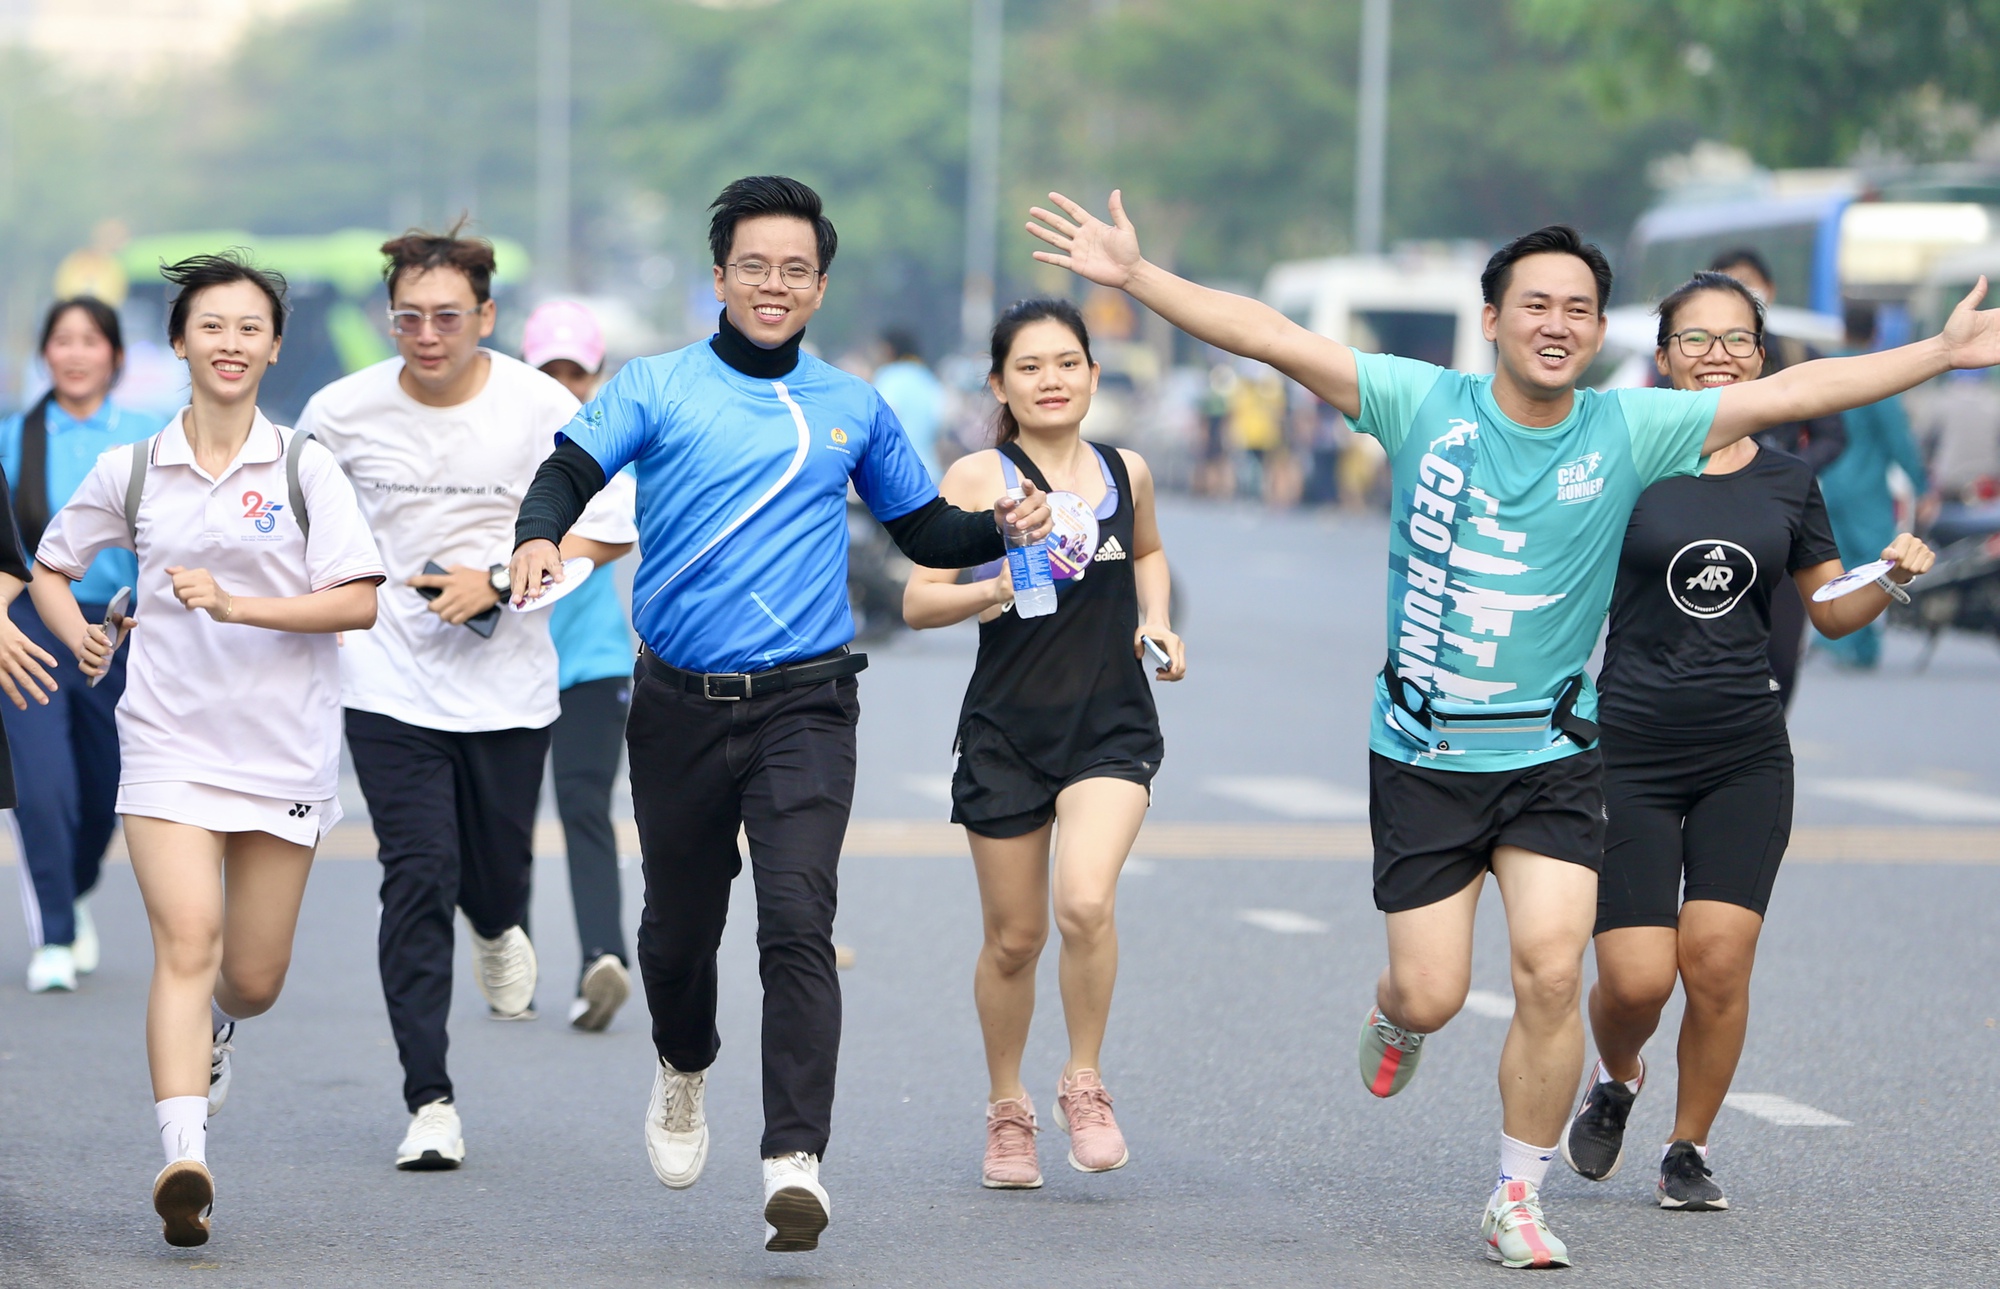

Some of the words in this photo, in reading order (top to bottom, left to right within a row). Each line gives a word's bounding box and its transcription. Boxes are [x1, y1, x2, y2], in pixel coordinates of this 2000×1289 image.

[1558, 463, 1586, 485] CEO
[1557, 478, 1604, 500] RUNNER
[1410, 453, 1465, 554] CEO
[1094, 551, 1126, 562] adidas
[1686, 565, 1734, 591] AR
[1397, 555, 1447, 693] RUNN
